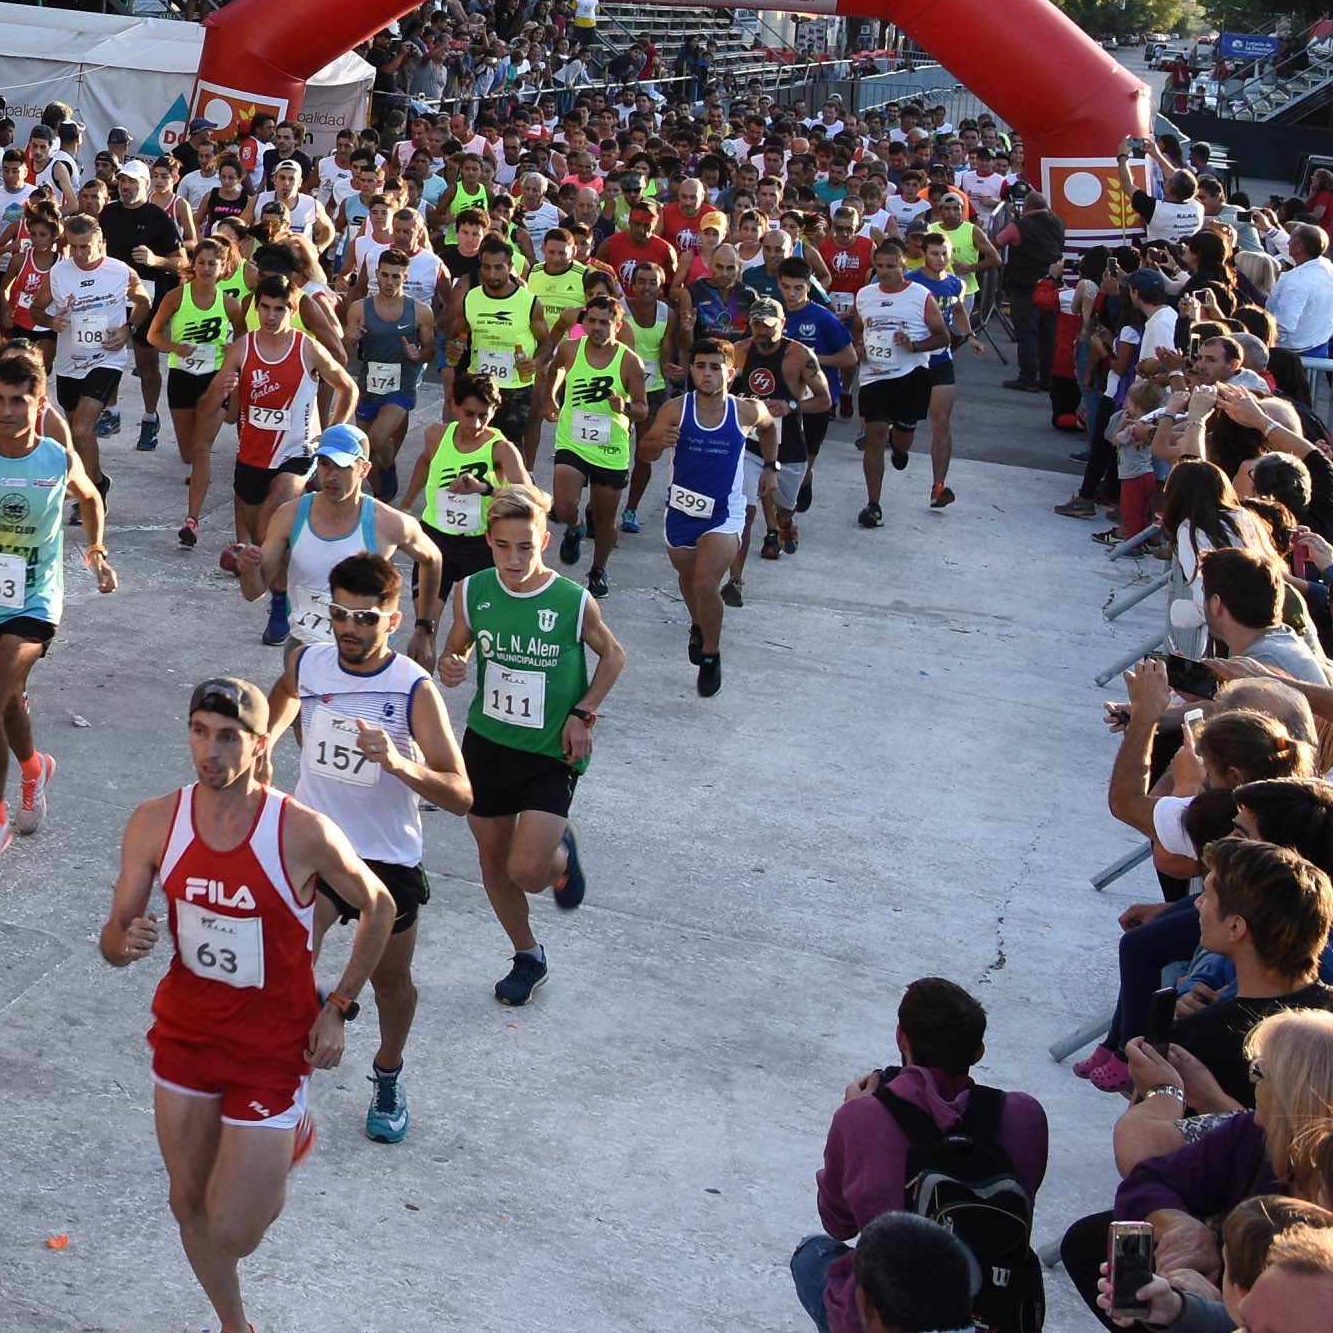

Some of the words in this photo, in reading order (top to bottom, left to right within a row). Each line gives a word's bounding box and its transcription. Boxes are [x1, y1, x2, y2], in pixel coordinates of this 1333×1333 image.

[77, 330, 103, 343] 108
[868, 345, 892, 359] 223
[186, 358, 205, 371] 97
[480, 362, 508, 379] 288
[371, 376, 395, 389] 174
[250, 381, 282, 403] Galas
[253, 407, 285, 424] 279
[580, 427, 600, 441] 12
[675, 493, 708, 513] 299
[444, 509, 468, 527] 52
[510, 634, 524, 653] N.
[526, 636, 560, 657] Alem
[496, 651, 558, 667] MUNICIPALIDAD
[492, 689, 532, 718] 111
[317, 740, 371, 776] 157
[185, 877, 256, 910] FILA
[196, 942, 238, 974] 63
